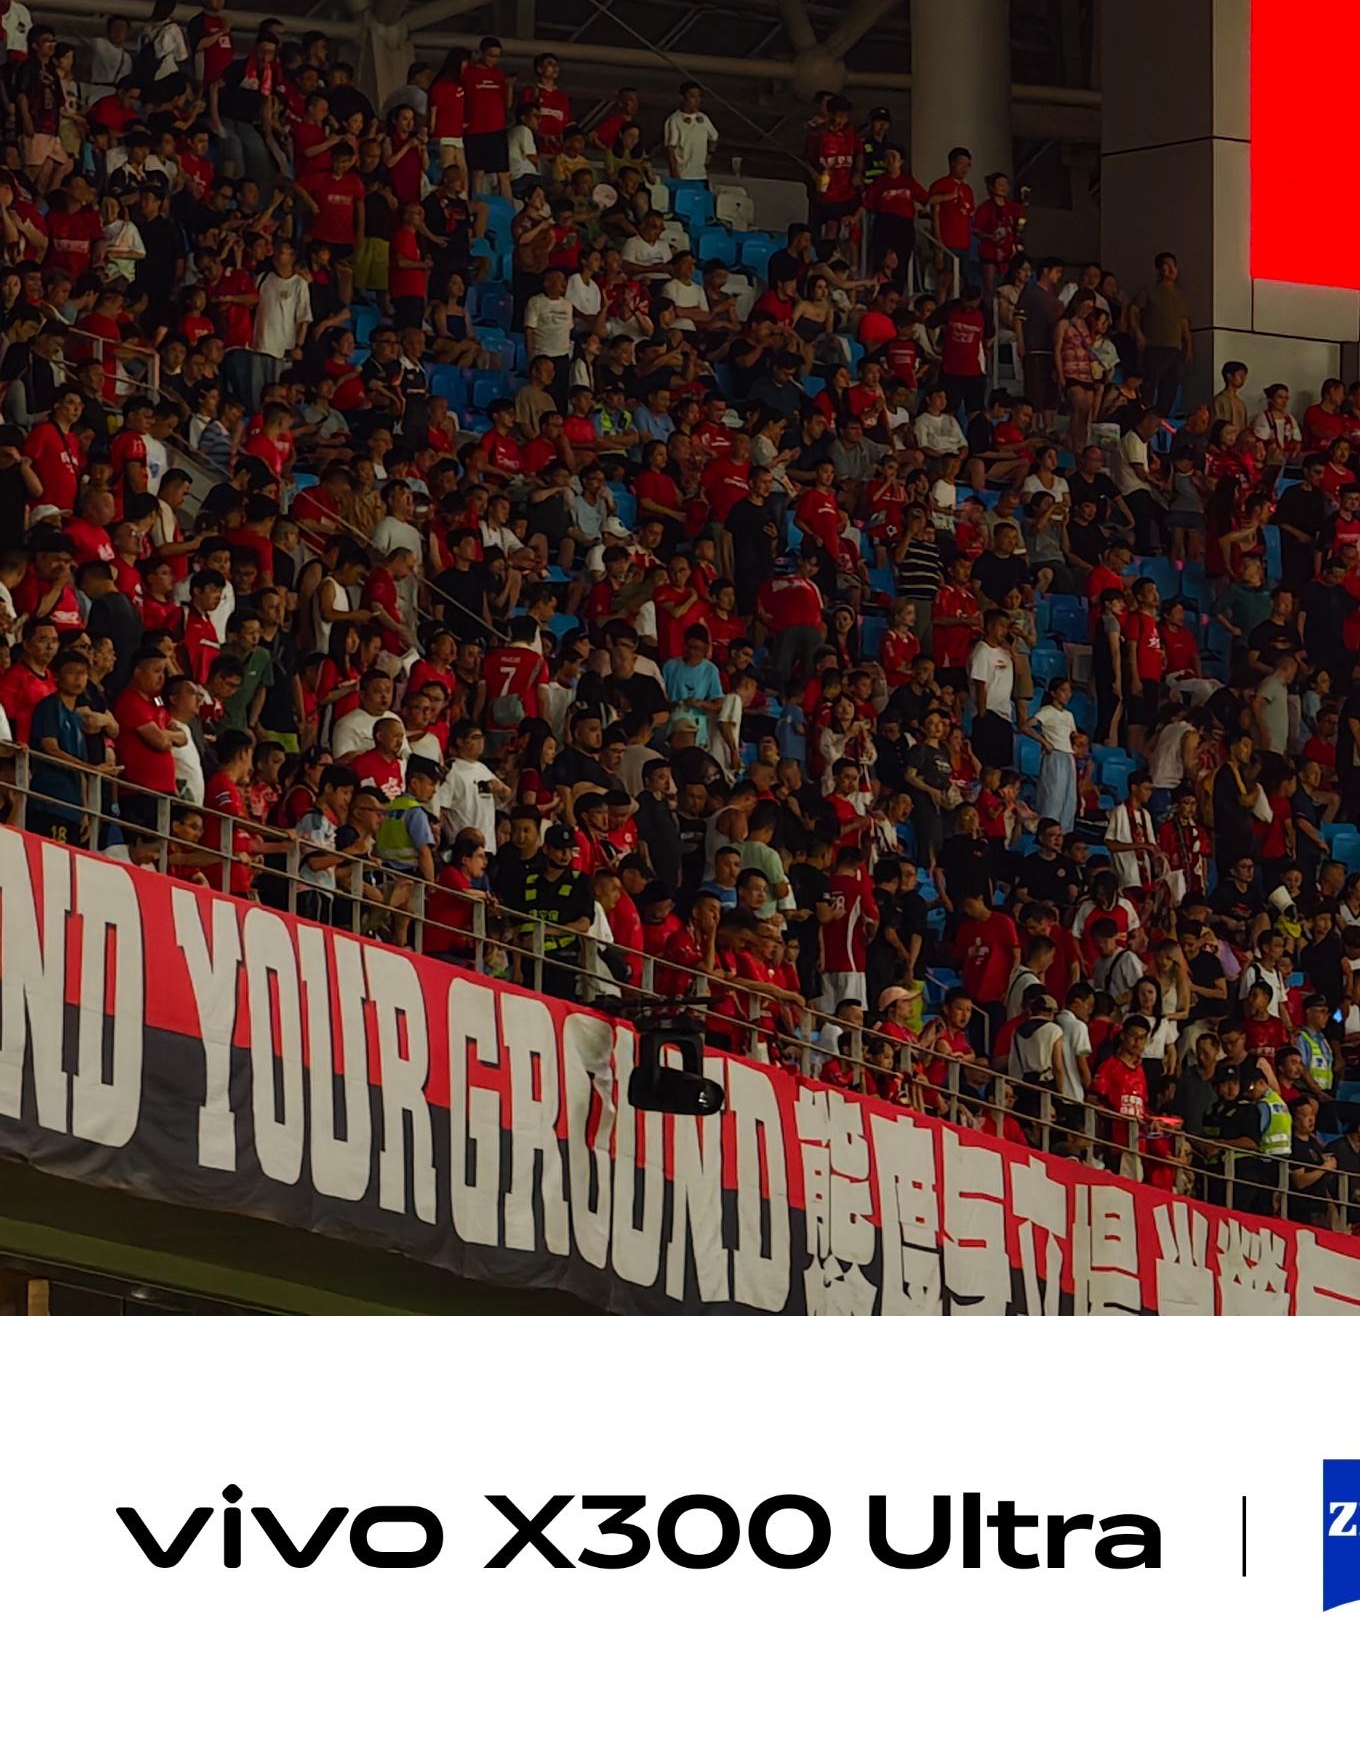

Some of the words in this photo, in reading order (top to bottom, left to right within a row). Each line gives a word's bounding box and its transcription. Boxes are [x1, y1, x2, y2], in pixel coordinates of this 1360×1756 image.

[500, 666, 517, 697] 7
[172, 886, 437, 1226] YOUR
[447, 976, 793, 1315] GROUND
